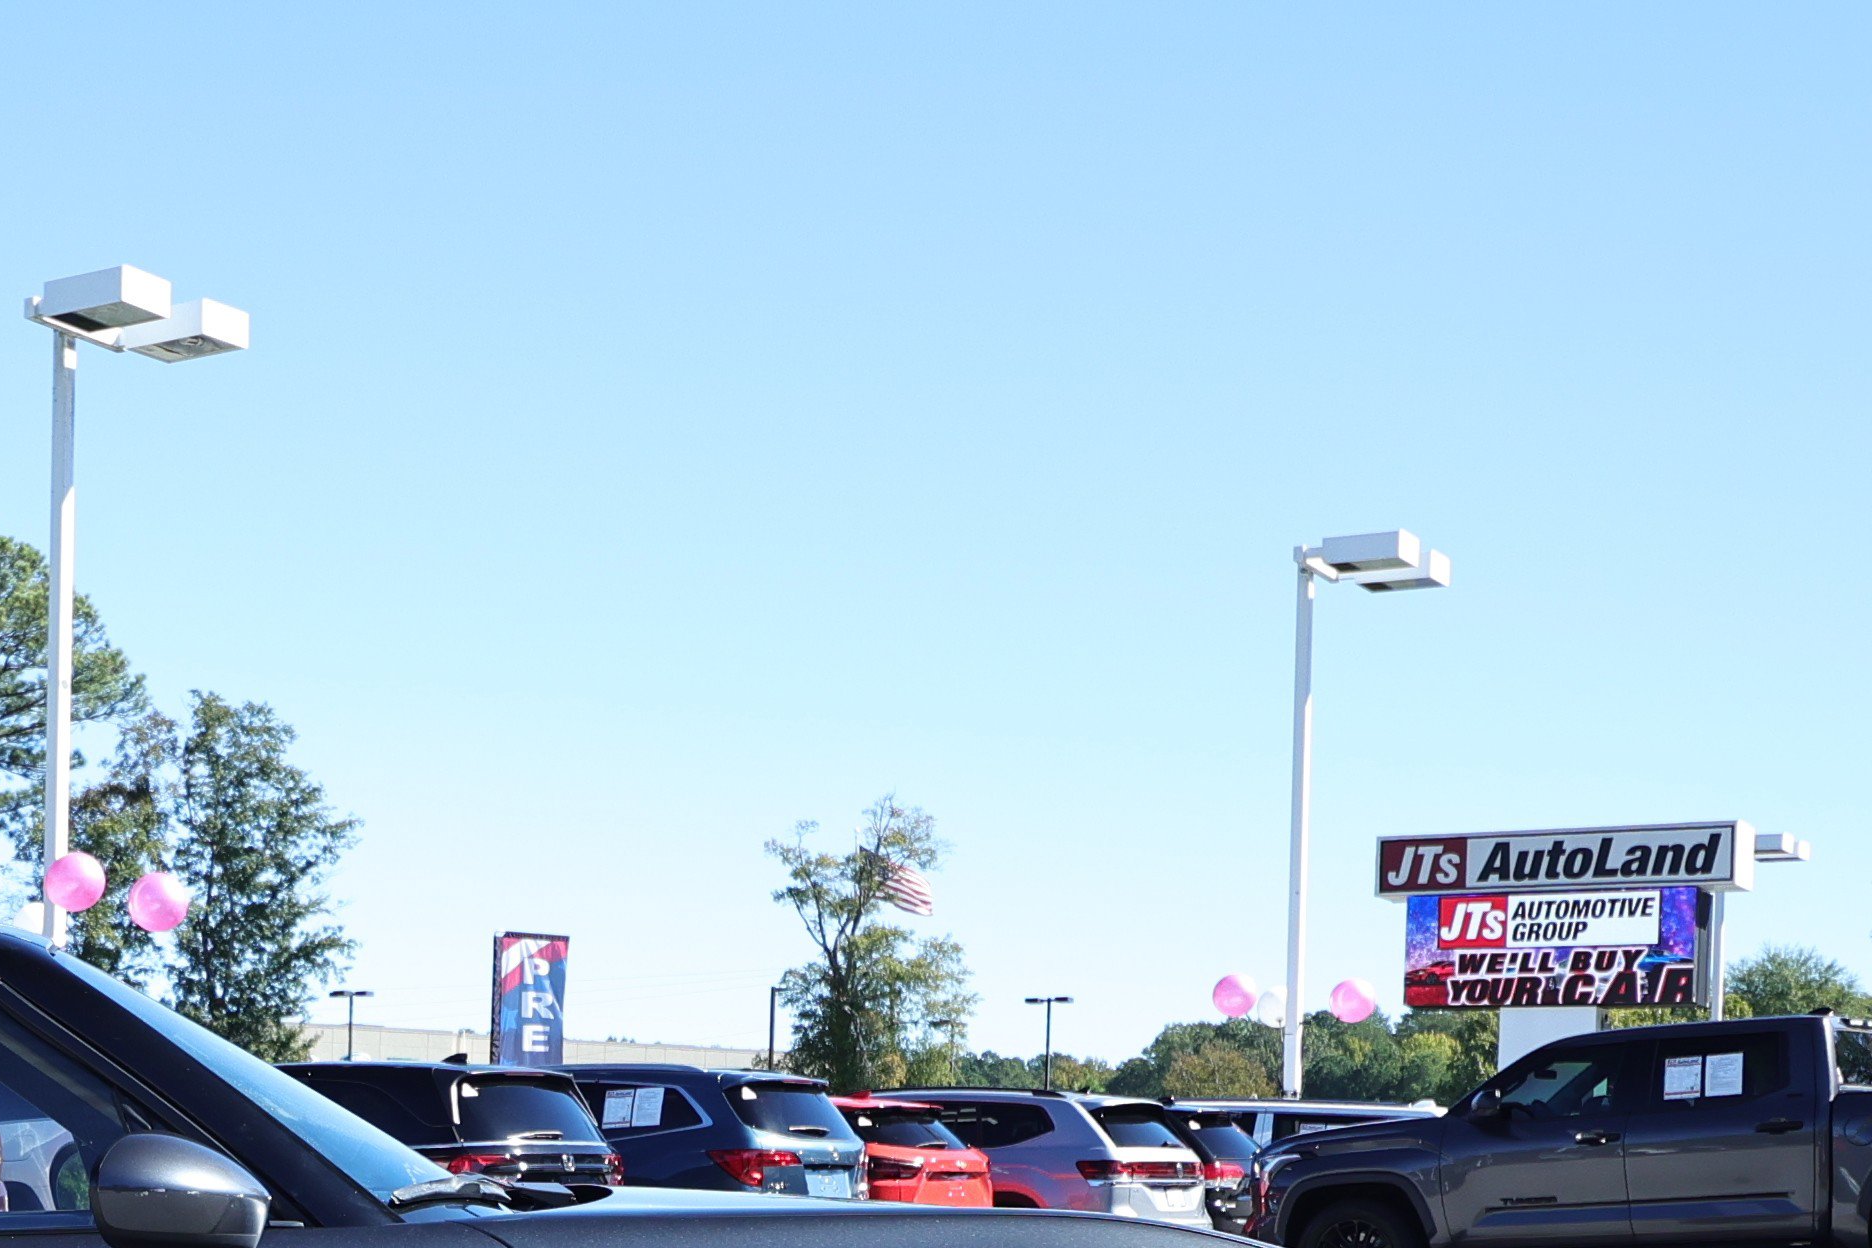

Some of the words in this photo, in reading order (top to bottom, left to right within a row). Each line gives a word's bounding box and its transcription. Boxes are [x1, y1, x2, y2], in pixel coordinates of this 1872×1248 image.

[1387, 845, 1461, 886] JTs
[1477, 834, 1722, 882] AutoLand
[1439, 901, 1506, 942] JTs
[1511, 897, 1656, 922] AUTOMOTIVE
[1512, 922, 1588, 943] GROUP
[1455, 950, 1556, 976] WE'LL
[1568, 949, 1646, 973] BUY
[1447, 975, 1546, 1005] YOUR
[1559, 963, 1695, 1006] CAR
[521, 957, 555, 1053] PRE
